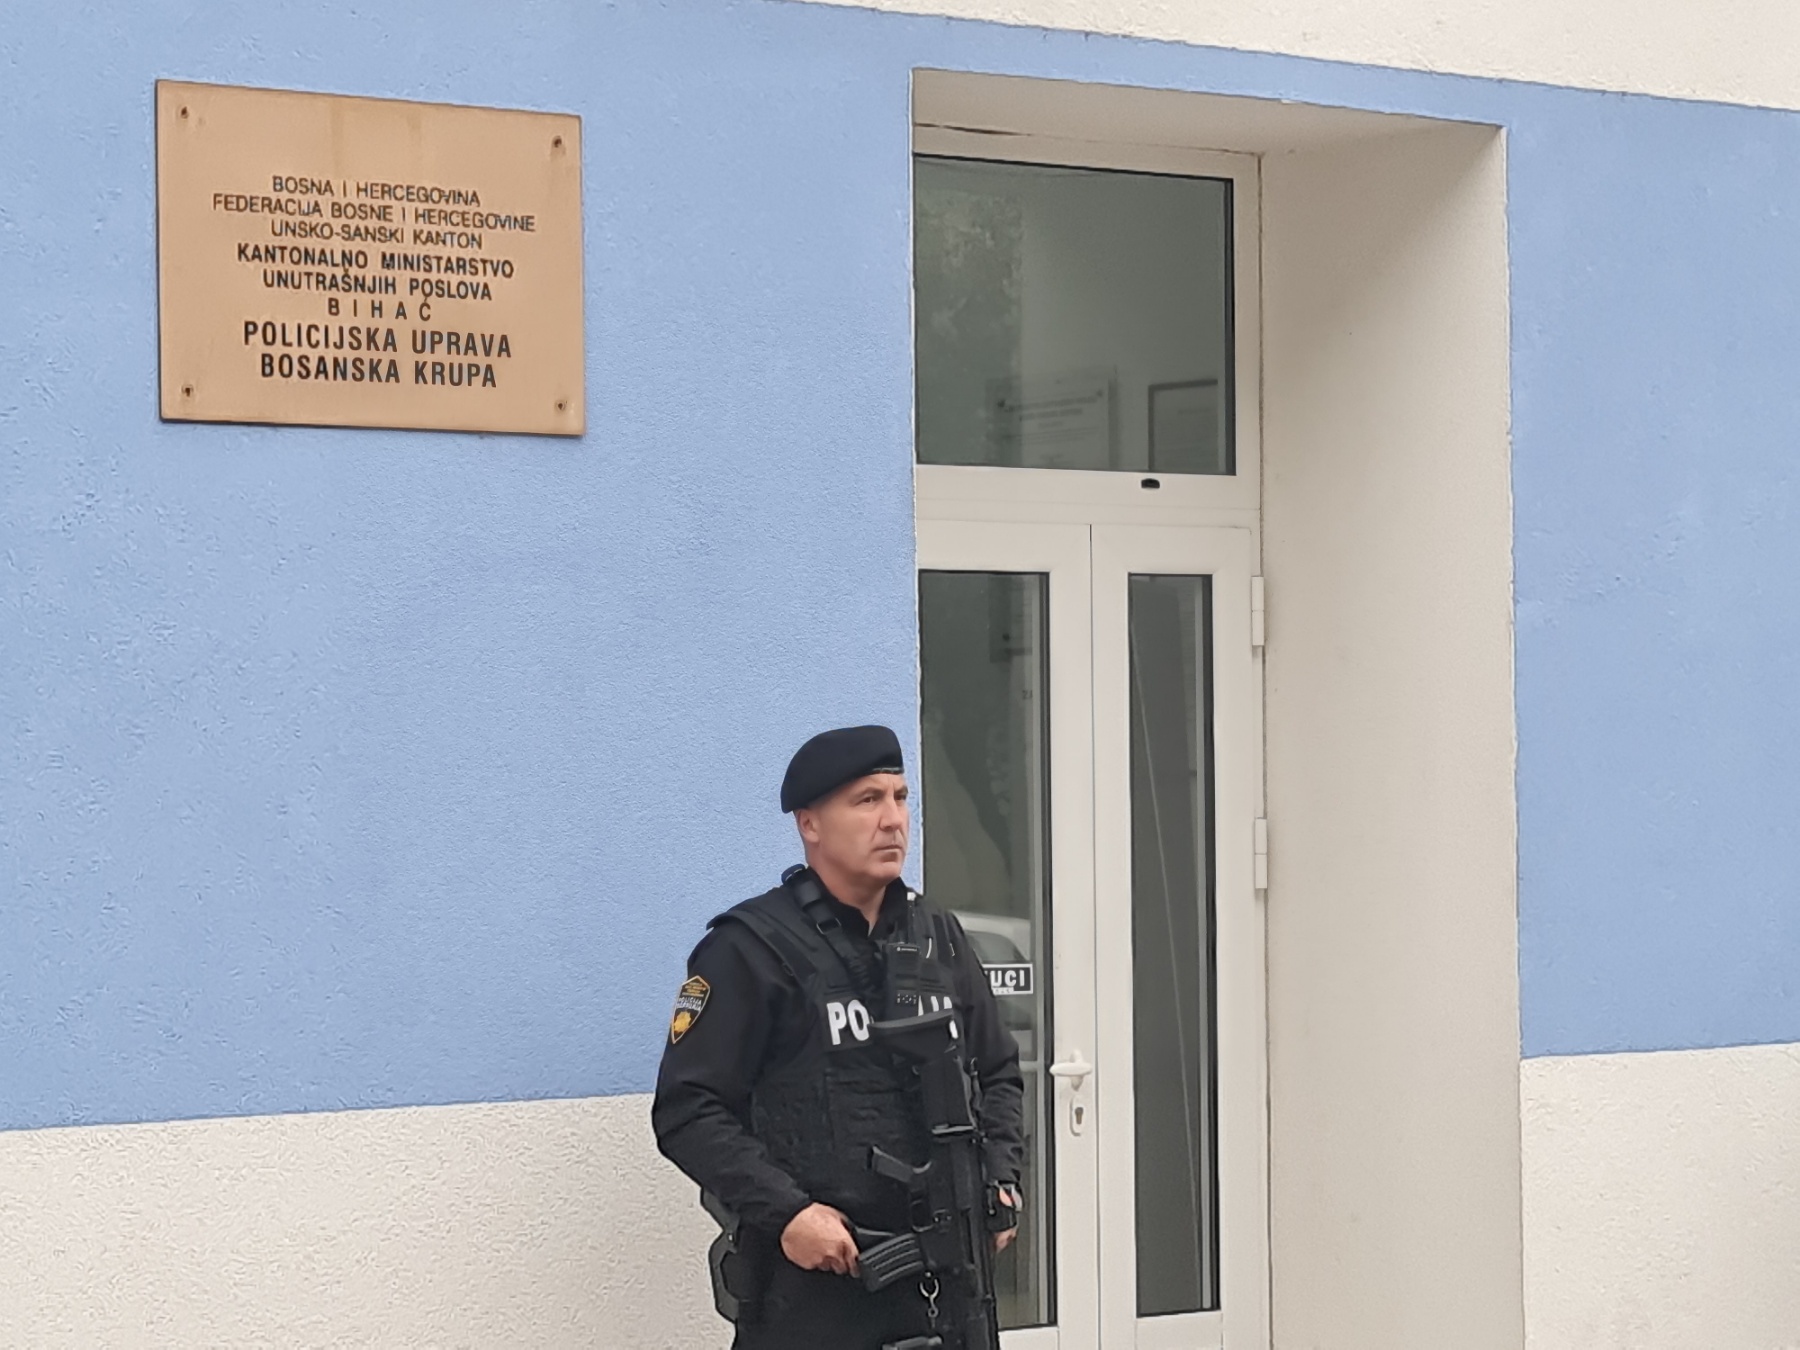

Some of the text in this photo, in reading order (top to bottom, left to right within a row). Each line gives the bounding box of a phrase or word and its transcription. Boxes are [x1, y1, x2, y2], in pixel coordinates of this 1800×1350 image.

[272, 175, 480, 207] BOSNA I HERCEGOVINA
[212, 193, 535, 232] FEDERACIJA BOSNE I HERCEGOVINE
[271, 219, 482, 250] UNSKO-SANSKI KANTON
[237, 243, 514, 279] KANTONALNO MINISTARSTVO
[263, 268, 492, 301] UNUTRAŠNJIH POSLOVA
[243, 320, 512, 358] POLICIJSKA UPRAVA
[260, 353, 497, 388] BOSANSKA KRUPA
[984, 969, 1026, 987] UCI
